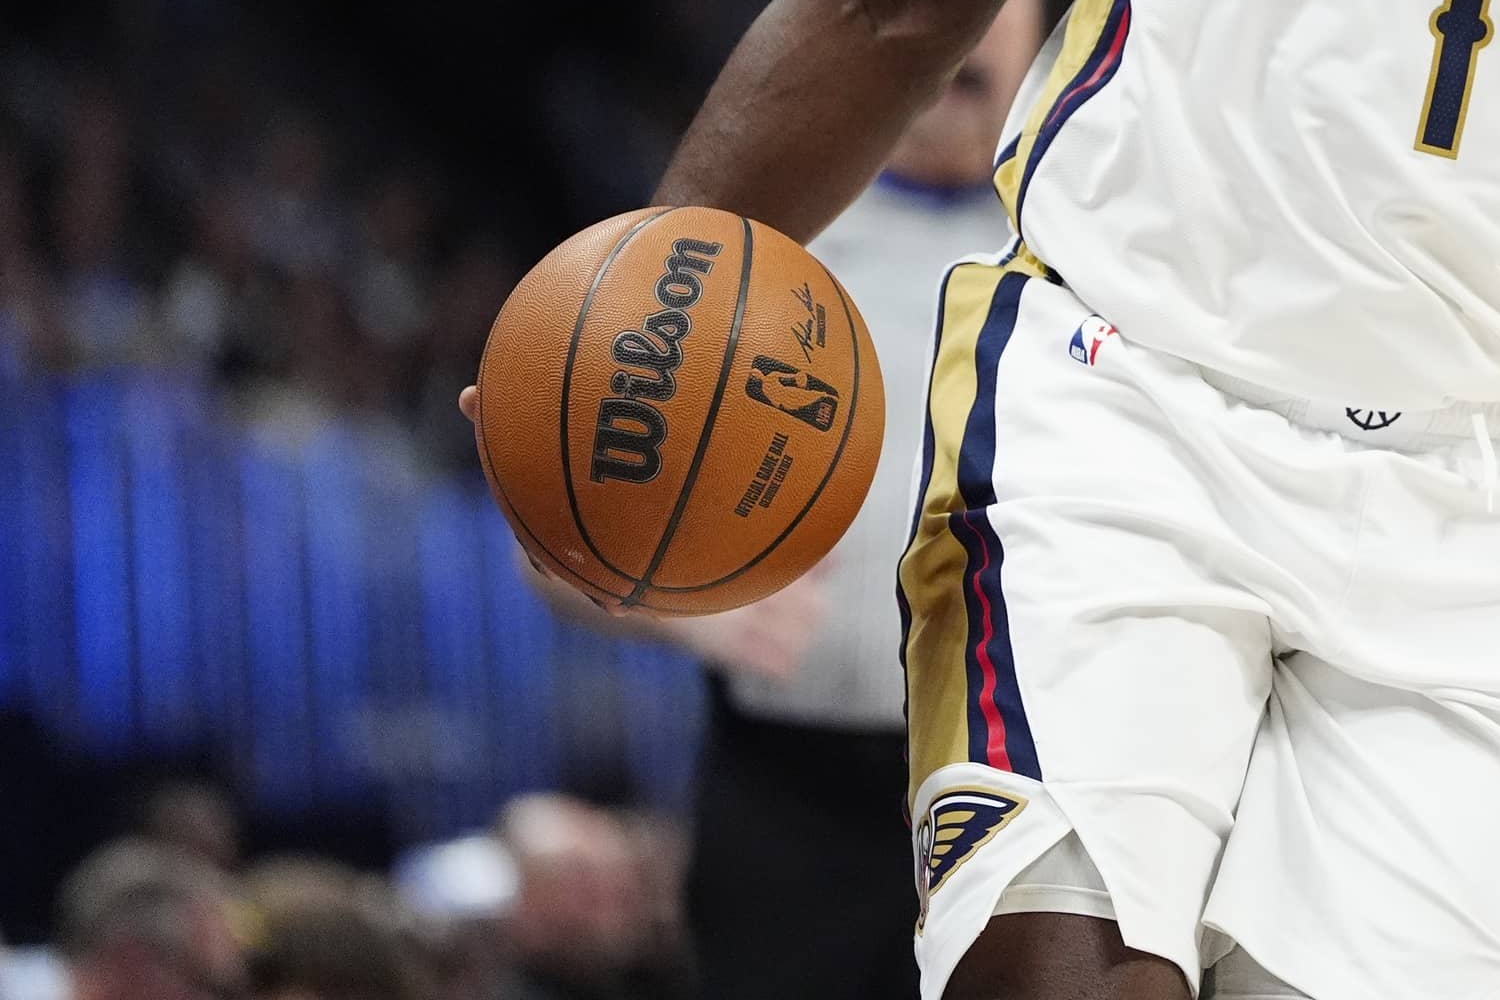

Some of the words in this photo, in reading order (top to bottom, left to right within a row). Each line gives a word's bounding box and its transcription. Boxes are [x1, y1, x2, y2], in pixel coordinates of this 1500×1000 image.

[590, 237, 723, 485] Wilson
[734, 479, 767, 518] OFFICIAL
[755, 454, 780, 481] GAME
[768, 431, 789, 457] BALL
[773, 454, 794, 482] LEATHER
